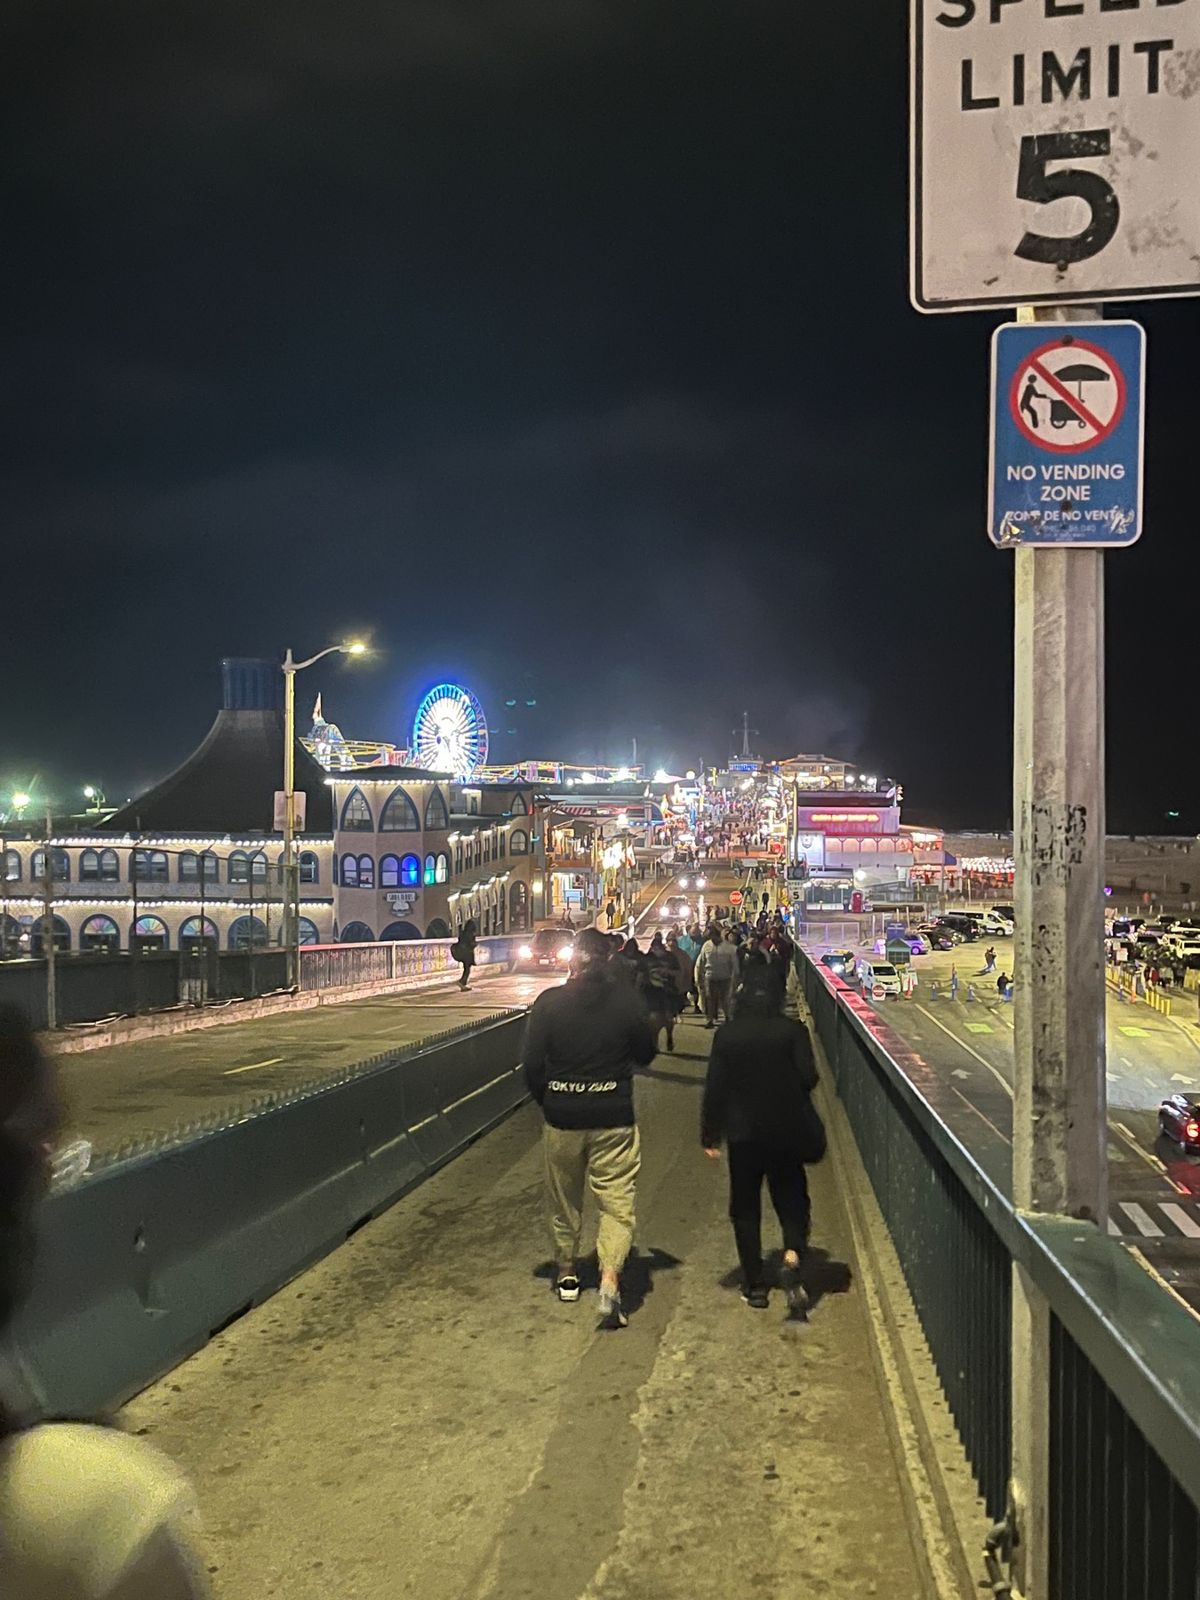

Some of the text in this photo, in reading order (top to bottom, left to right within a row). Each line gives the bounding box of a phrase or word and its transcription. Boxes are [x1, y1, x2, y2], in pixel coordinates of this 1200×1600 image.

[961, 39, 1174, 111] LIMIT
[1013, 129, 1120, 265] 5
[1007, 464, 1125, 481] NO VENDING
[1040, 485, 1091, 501] ZONE
[1006, 510, 1122, 522] ZON DE NO VENT
[793, 891, 800, 900] 5
